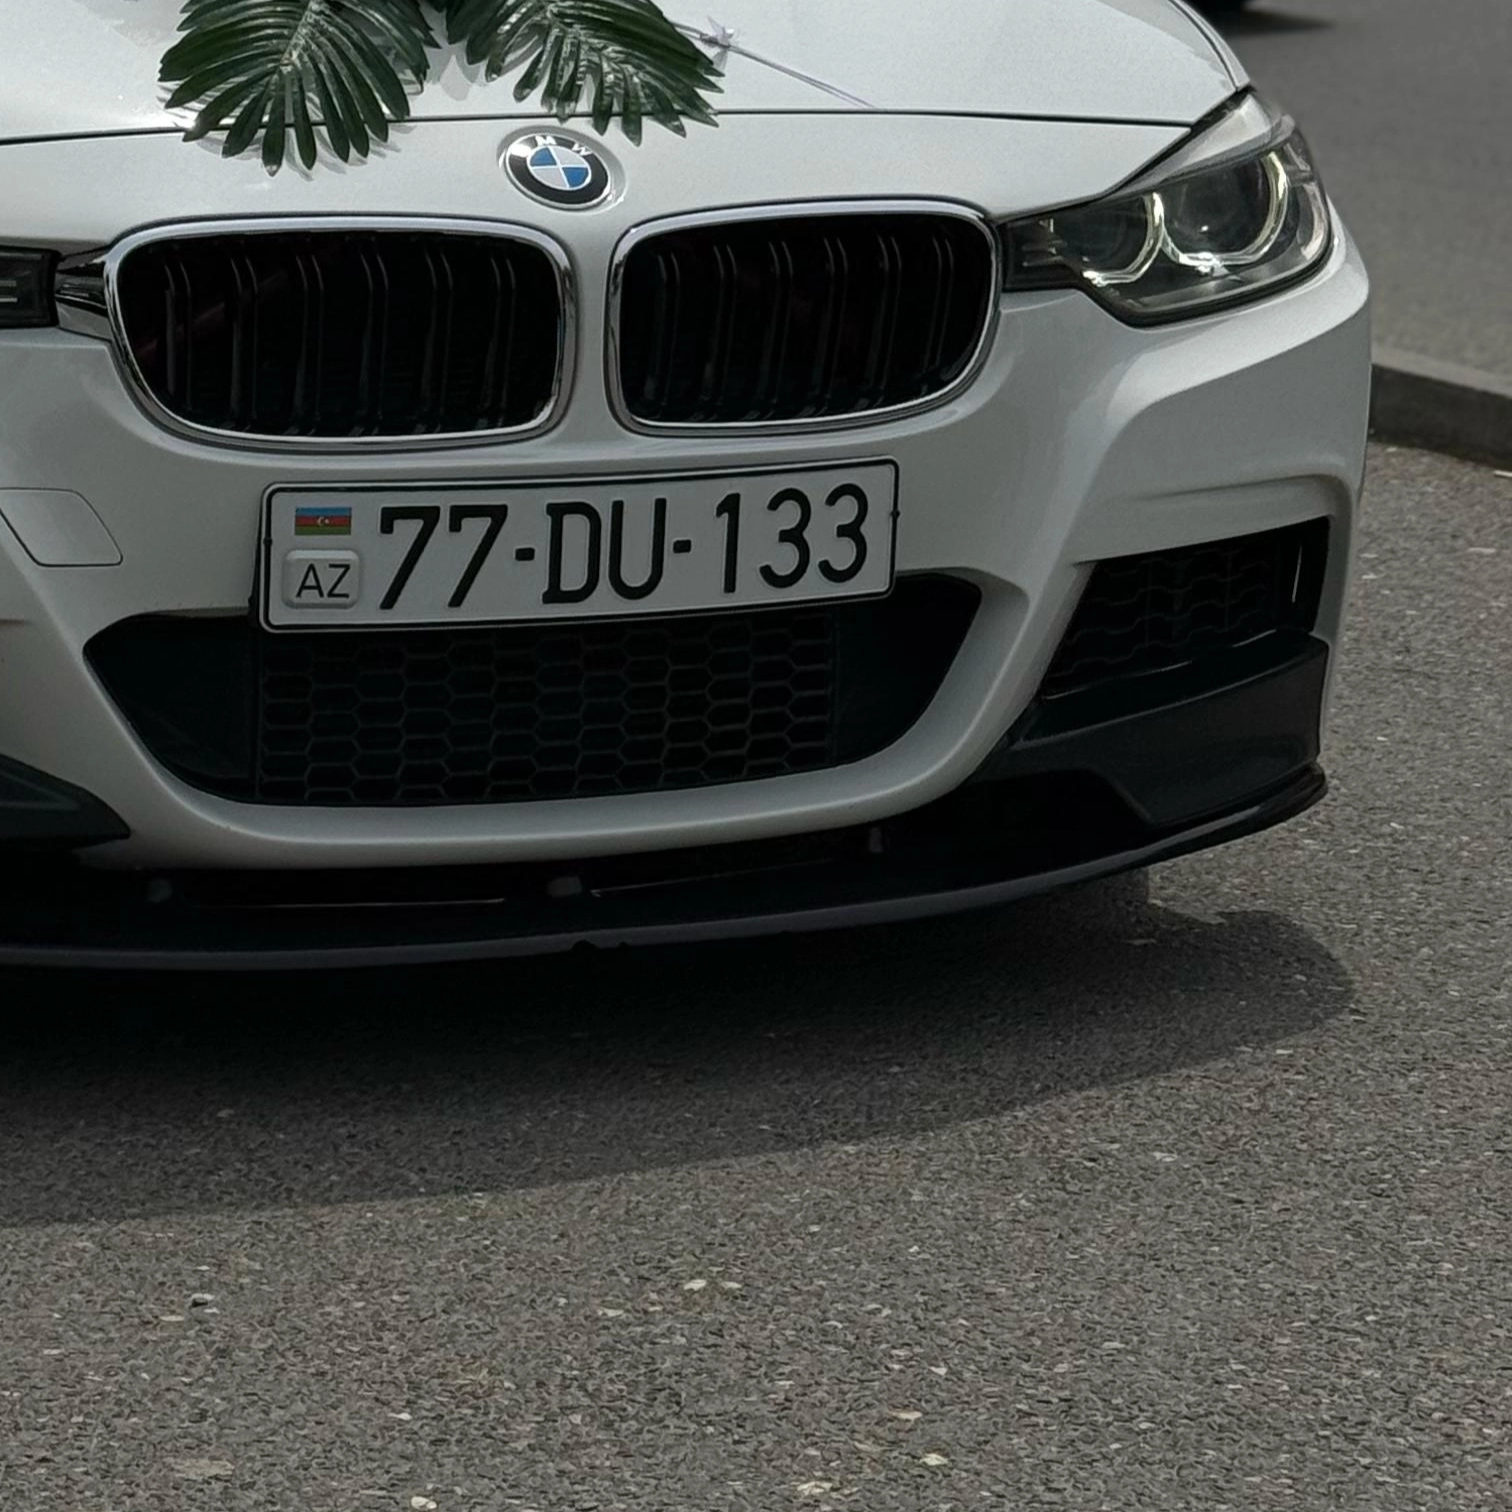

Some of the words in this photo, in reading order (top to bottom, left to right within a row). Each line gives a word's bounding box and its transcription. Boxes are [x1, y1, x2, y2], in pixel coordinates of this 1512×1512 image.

[510, 134, 594, 158] MW
[378, 482, 870, 611] 77-DU-133
[294, 562, 352, 600] AZ
